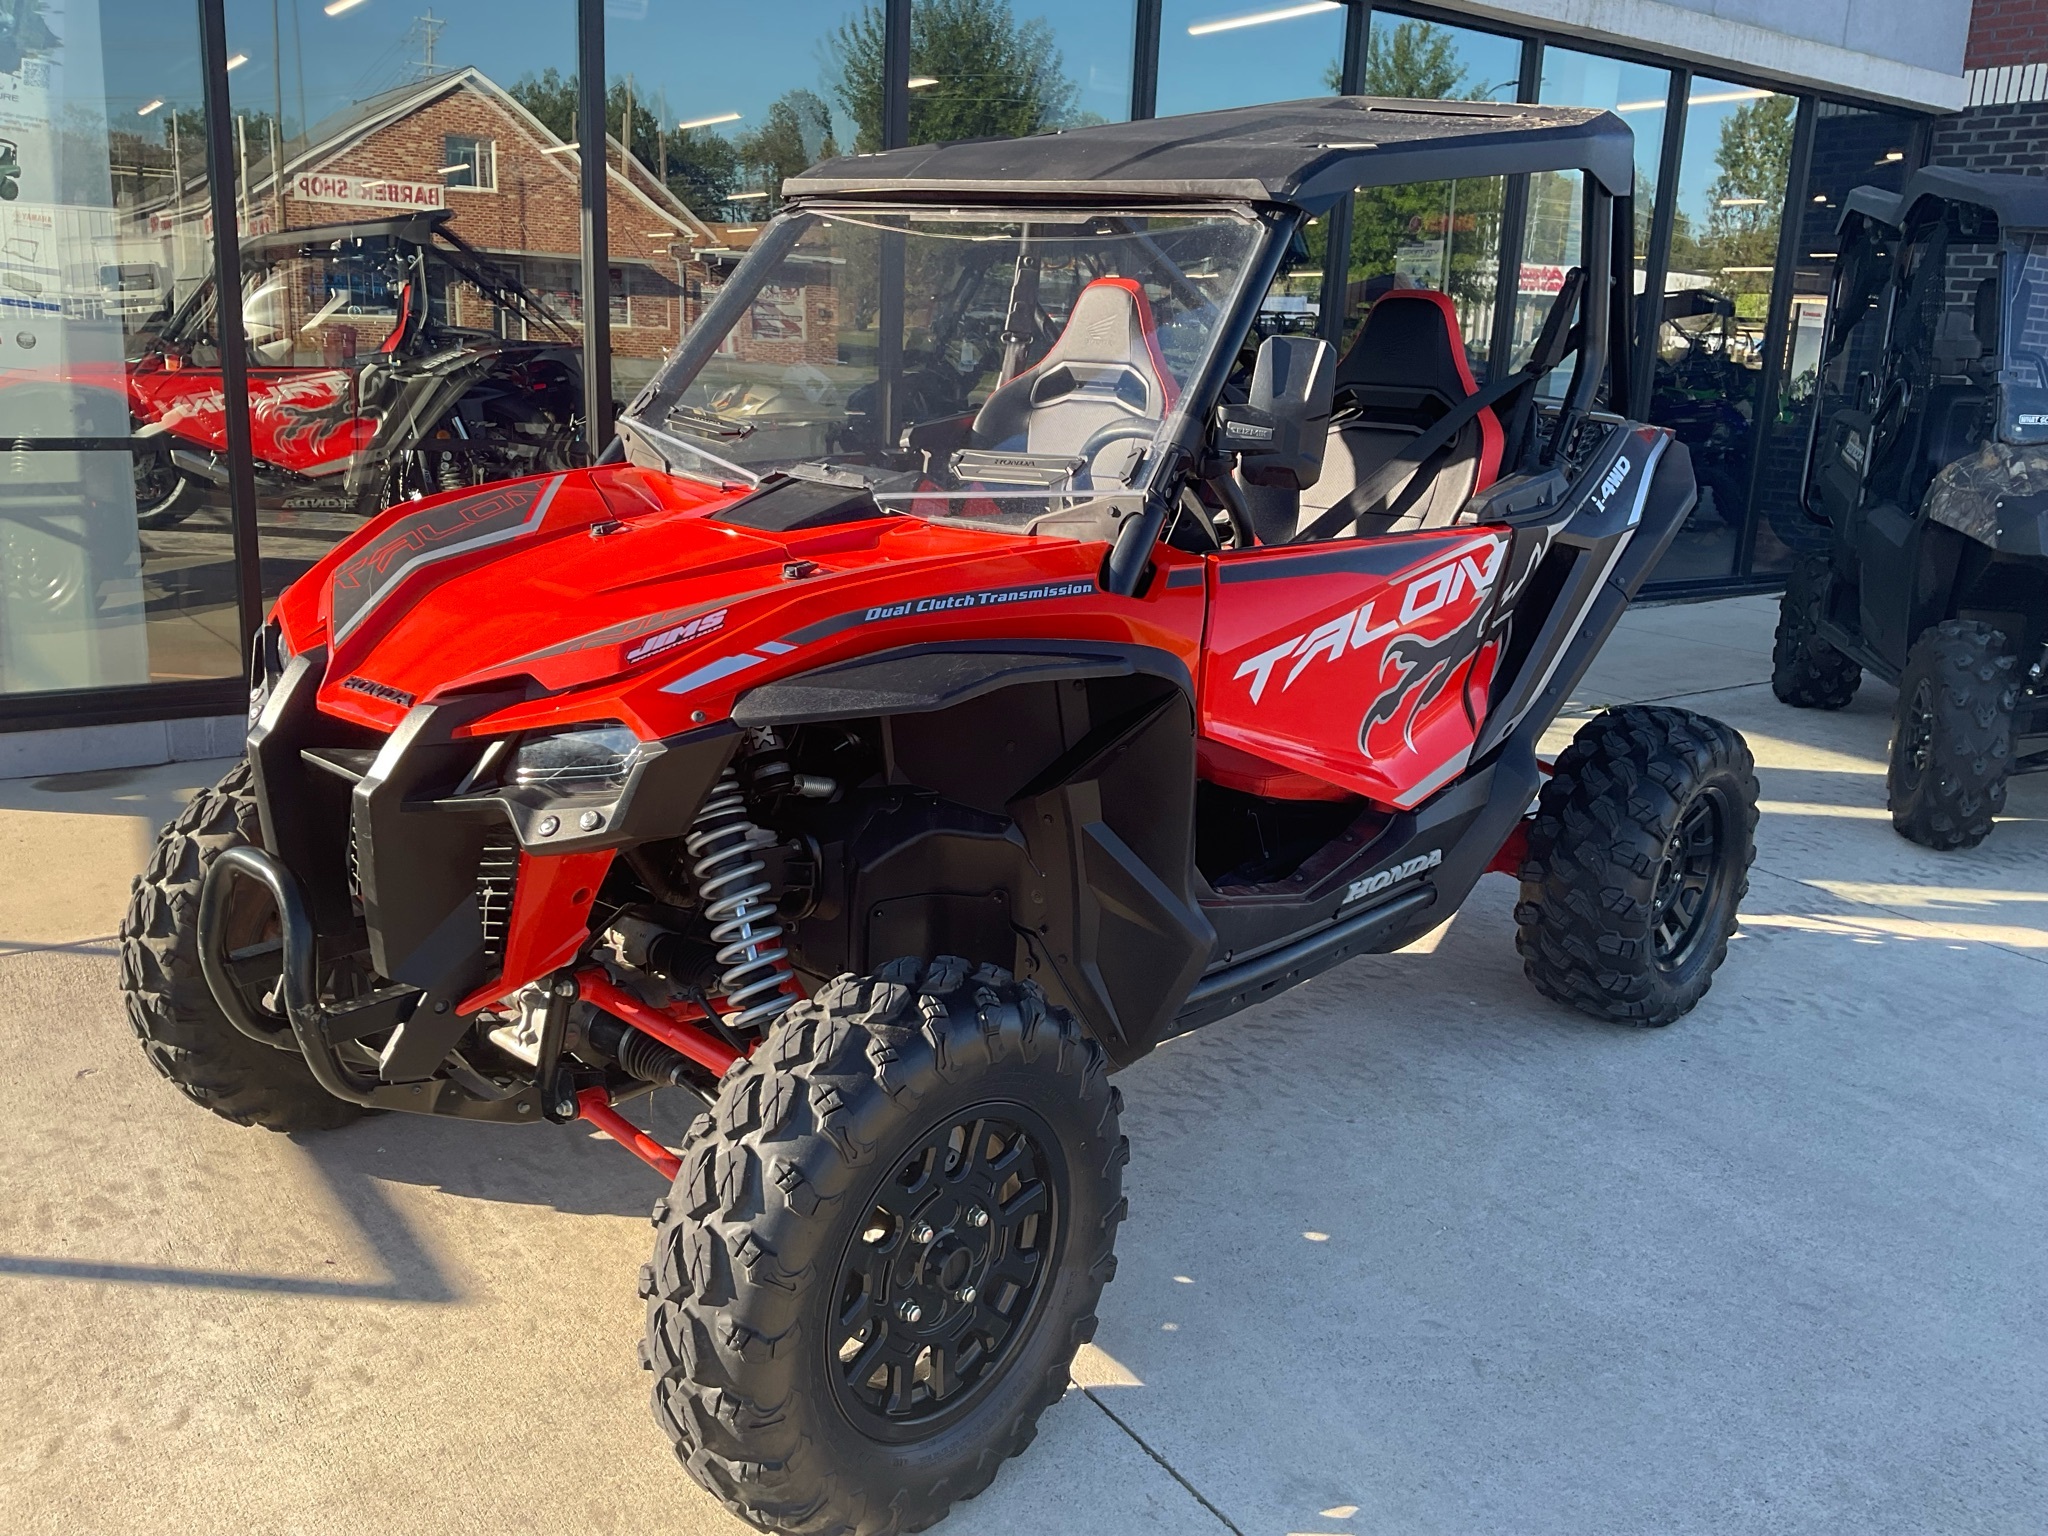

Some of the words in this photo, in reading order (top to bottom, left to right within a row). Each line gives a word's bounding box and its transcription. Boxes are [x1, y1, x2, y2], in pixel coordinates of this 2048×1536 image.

[1591, 455, 1630, 513] i-4WD
[864, 602, 911, 621] Dual
[916, 592, 975, 612] Clutch
[978, 583, 1092, 604] Transmission
[1232, 539, 1508, 706] TALON
[627, 609, 728, 660] JIMS
[343, 676, 418, 708] HONDA
[1342, 851, 1442, 904] HONDA
